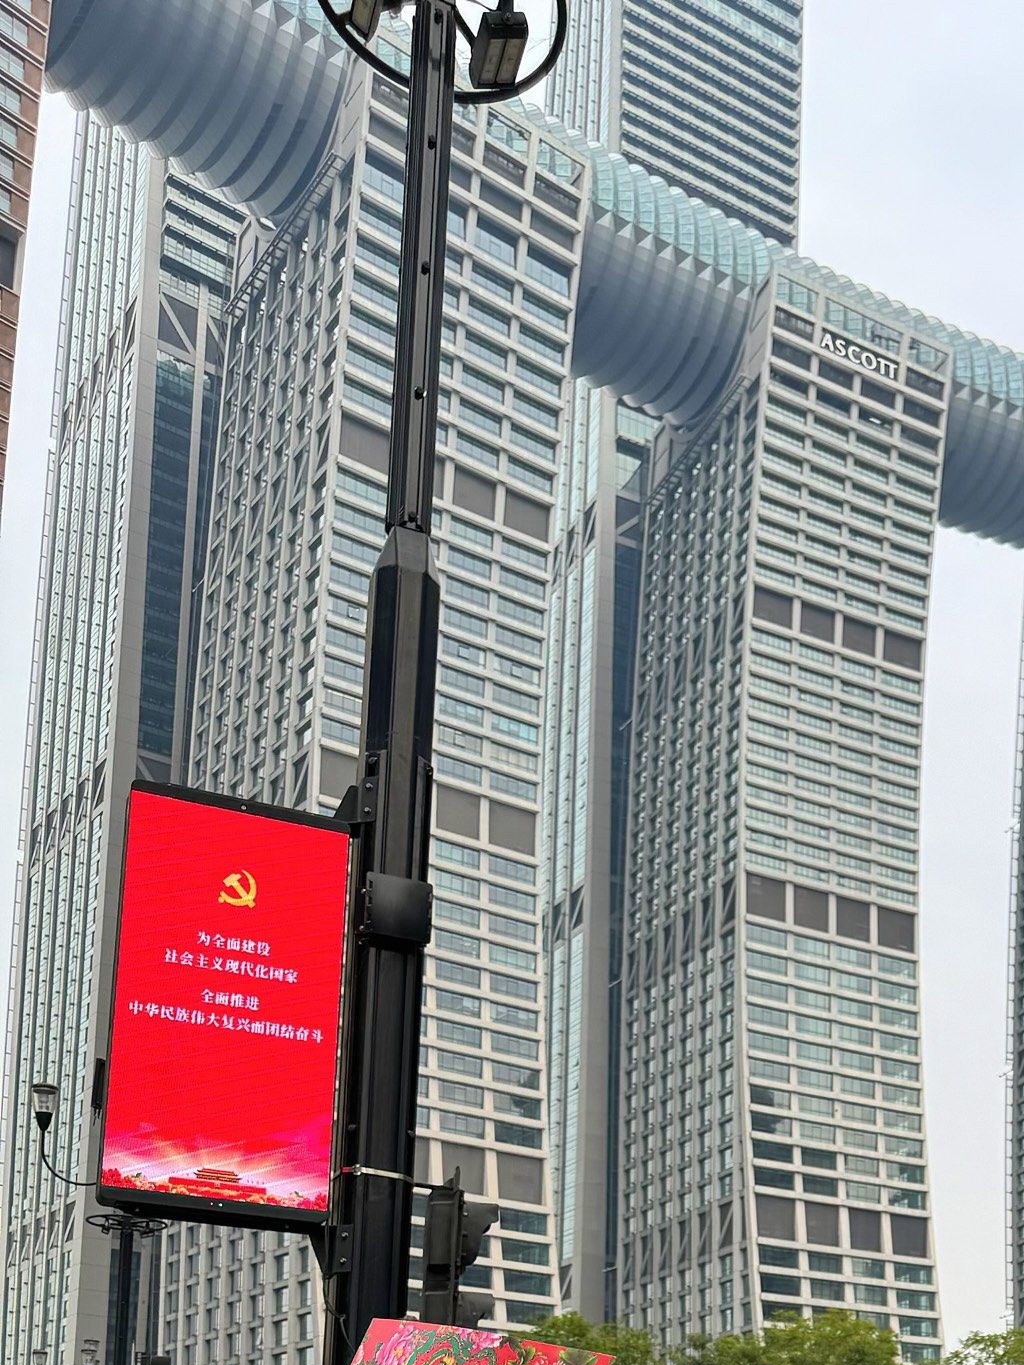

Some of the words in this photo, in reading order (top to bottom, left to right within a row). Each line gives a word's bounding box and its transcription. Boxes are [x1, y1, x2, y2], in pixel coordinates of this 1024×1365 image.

[821, 333, 899, 380] ASCOTT
[197, 931, 271, 957] 为全面建设
[164, 948, 299, 984] 社会主义现代化国家
[201, 988, 260, 1012] 全面推进
[128, 1000, 325, 1044] 中华民族伟大复兴而团结奋斗
